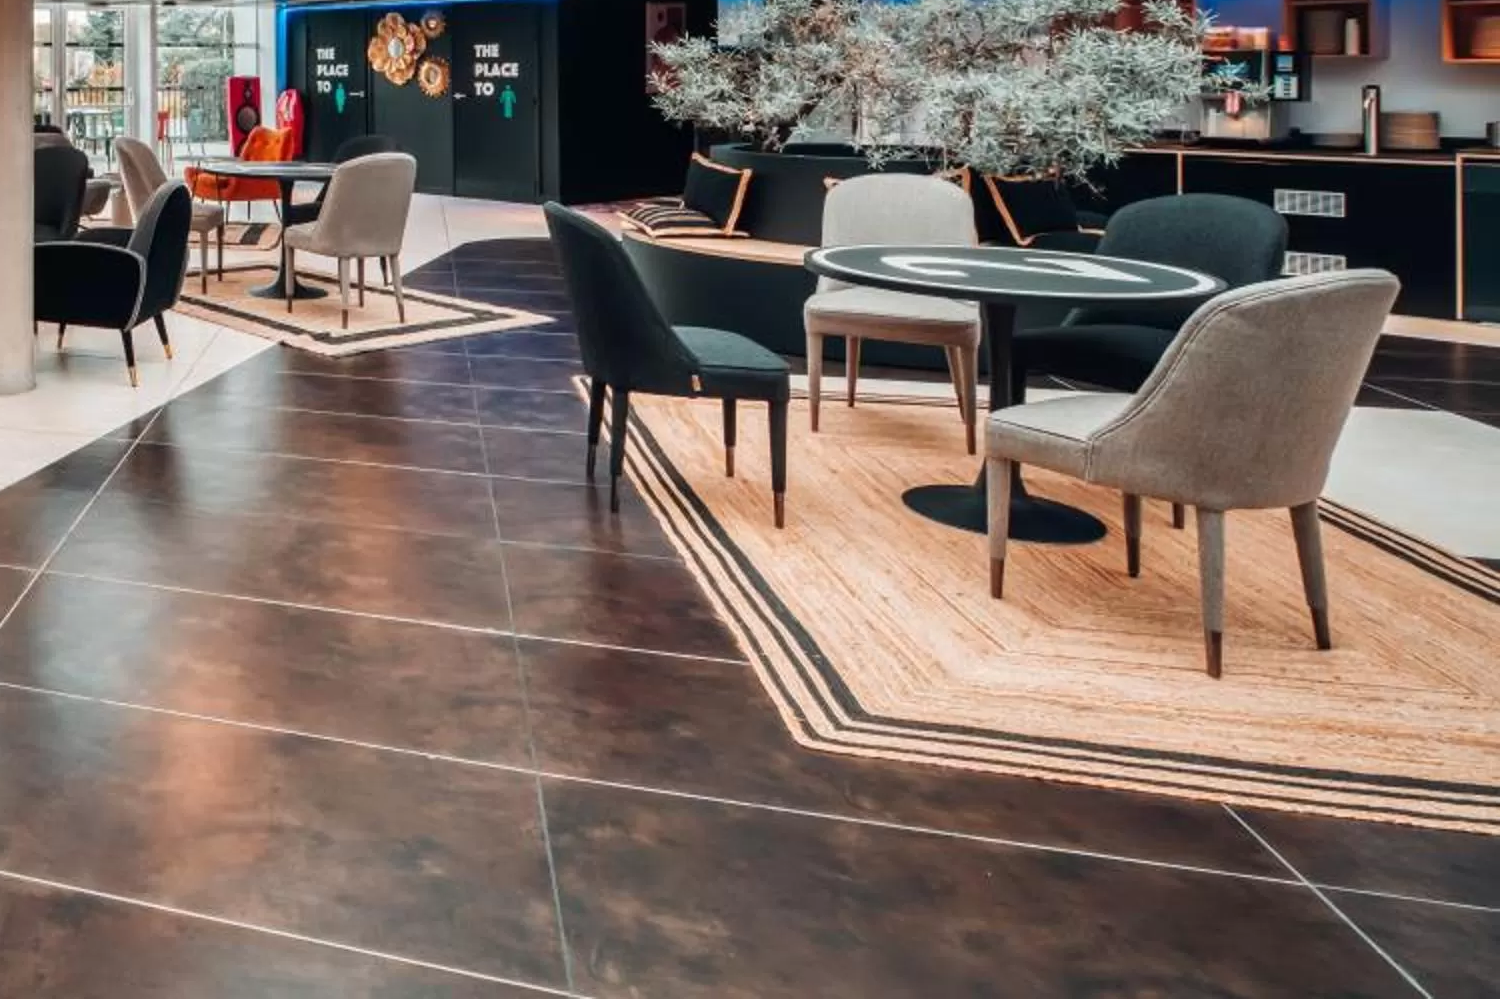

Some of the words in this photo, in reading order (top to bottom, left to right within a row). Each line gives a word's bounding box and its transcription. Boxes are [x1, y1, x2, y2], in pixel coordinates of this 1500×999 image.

[316, 48, 335, 60] THE
[474, 44, 499, 58] THE
[316, 65, 349, 77] PLACE
[474, 63, 519, 78] PLACE
[316, 81, 331, 93] TO
[474, 83, 495, 96] TO
